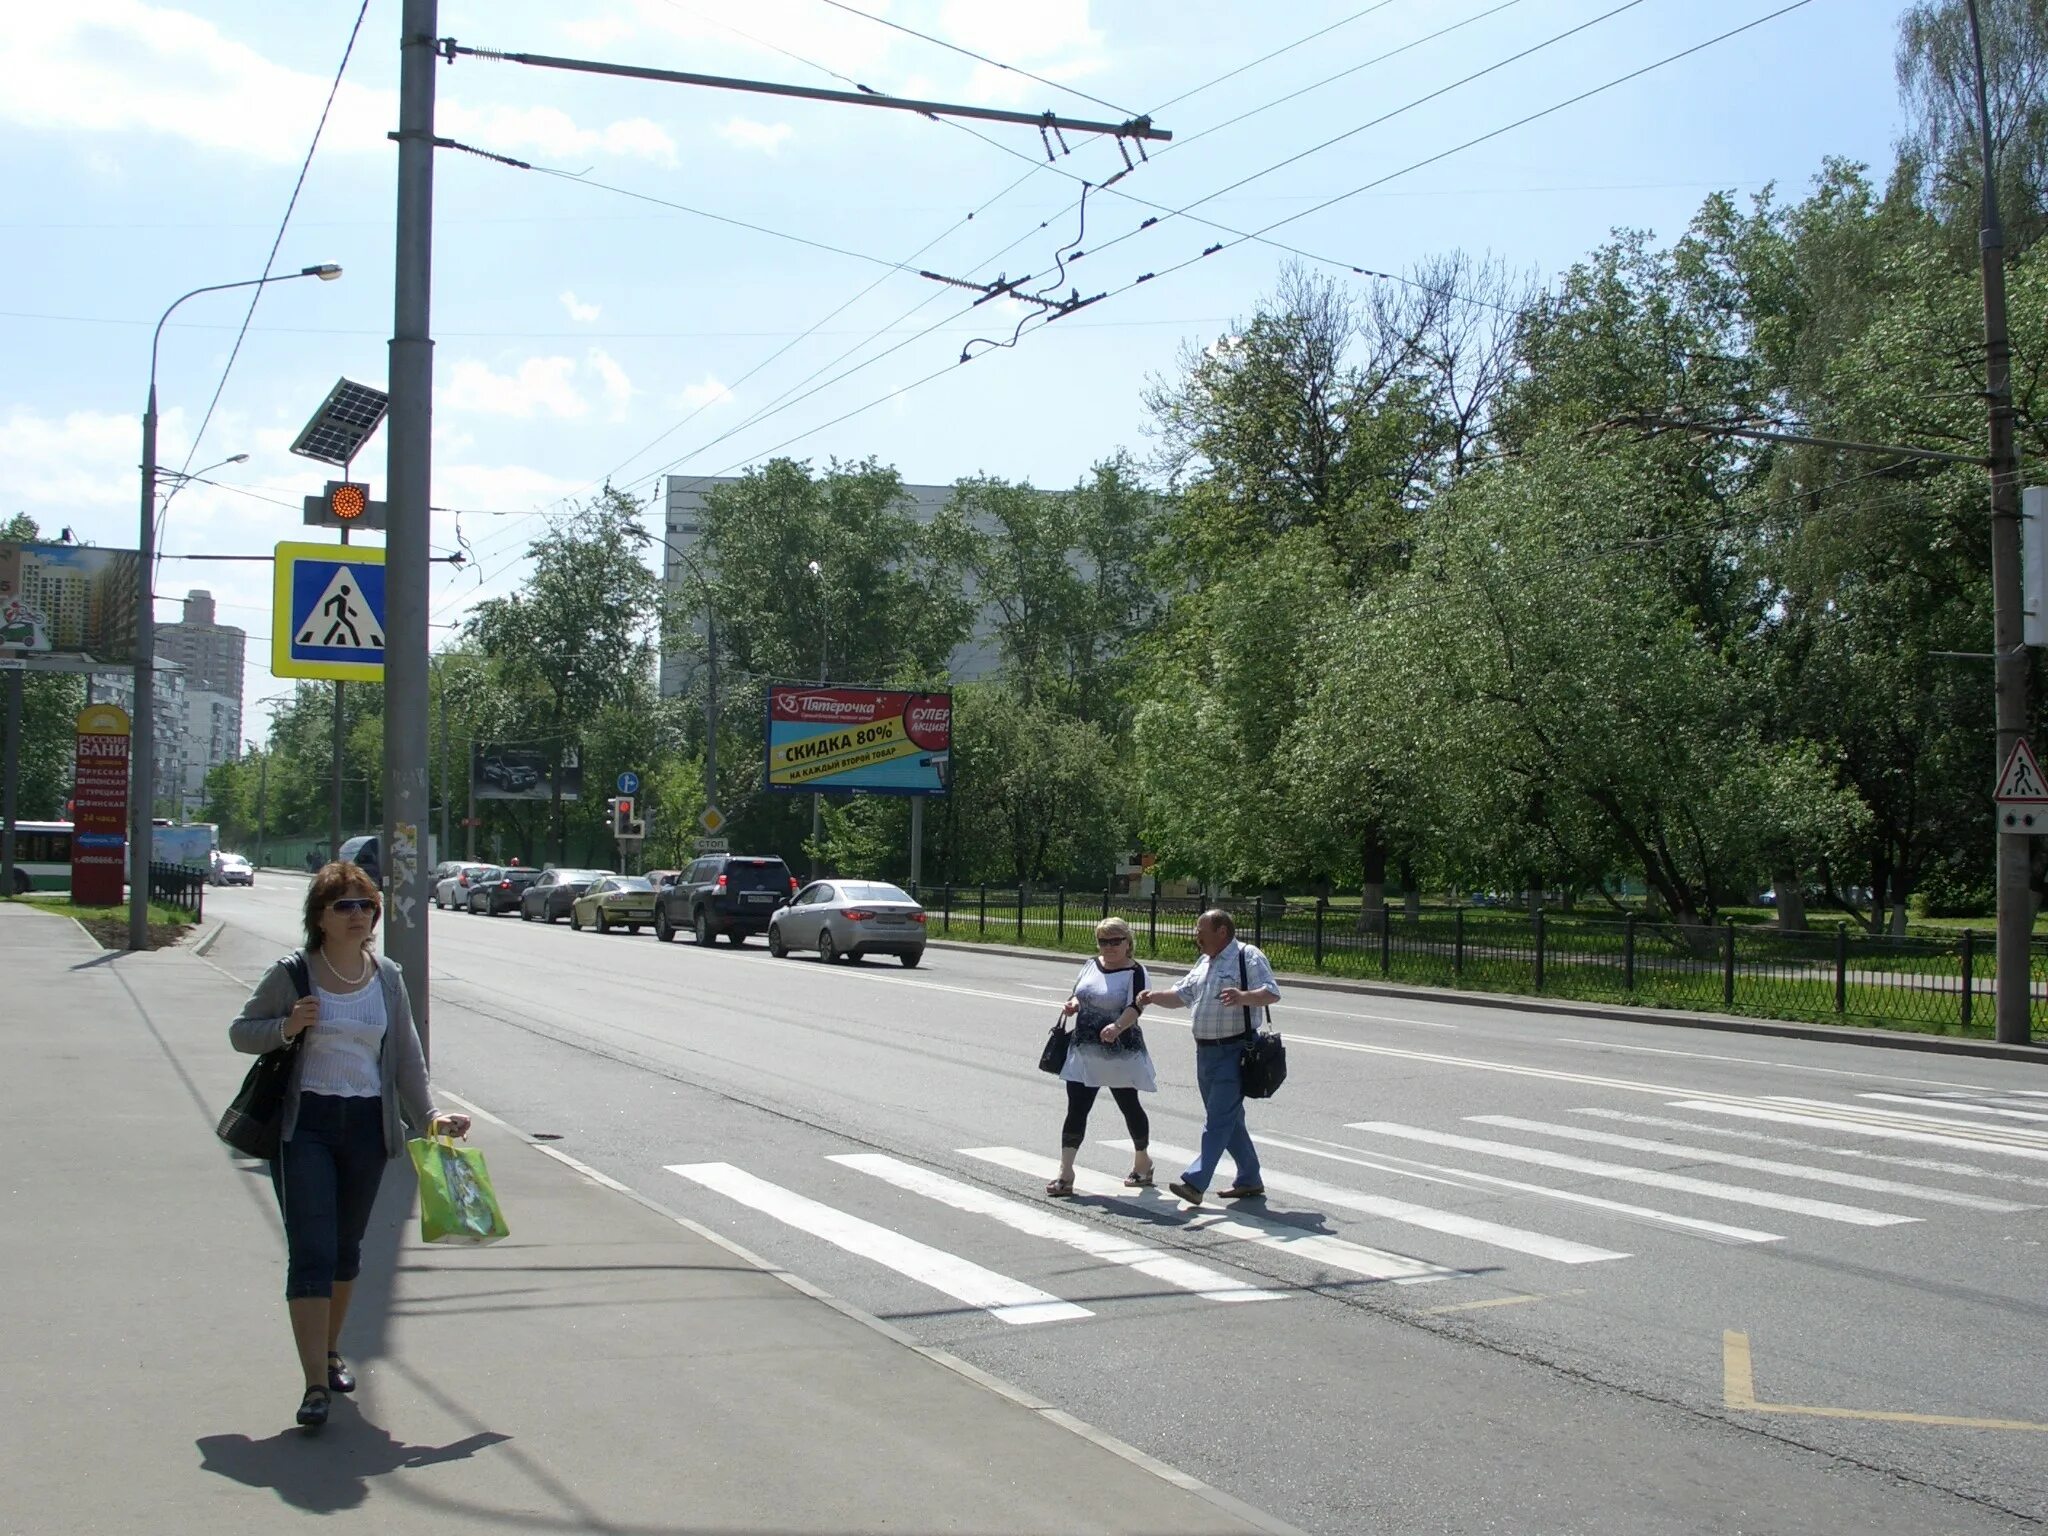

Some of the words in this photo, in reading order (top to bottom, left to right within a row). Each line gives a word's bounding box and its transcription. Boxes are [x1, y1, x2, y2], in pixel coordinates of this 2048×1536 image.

[912, 708, 950, 720] СУПЕР
[912, 720, 950, 733] АКЦИЯ!
[79, 744, 128, 756] БАНИ
[786, 735, 852, 761] СКИДКА
[789, 771, 801, 780] НА
[802, 761, 840, 776] КАЖДЫЙ
[841, 751, 871, 767] ВТОРОЙ
[872, 747, 897, 760] ТОВАР
[699, 840, 724, 848] СТОП
